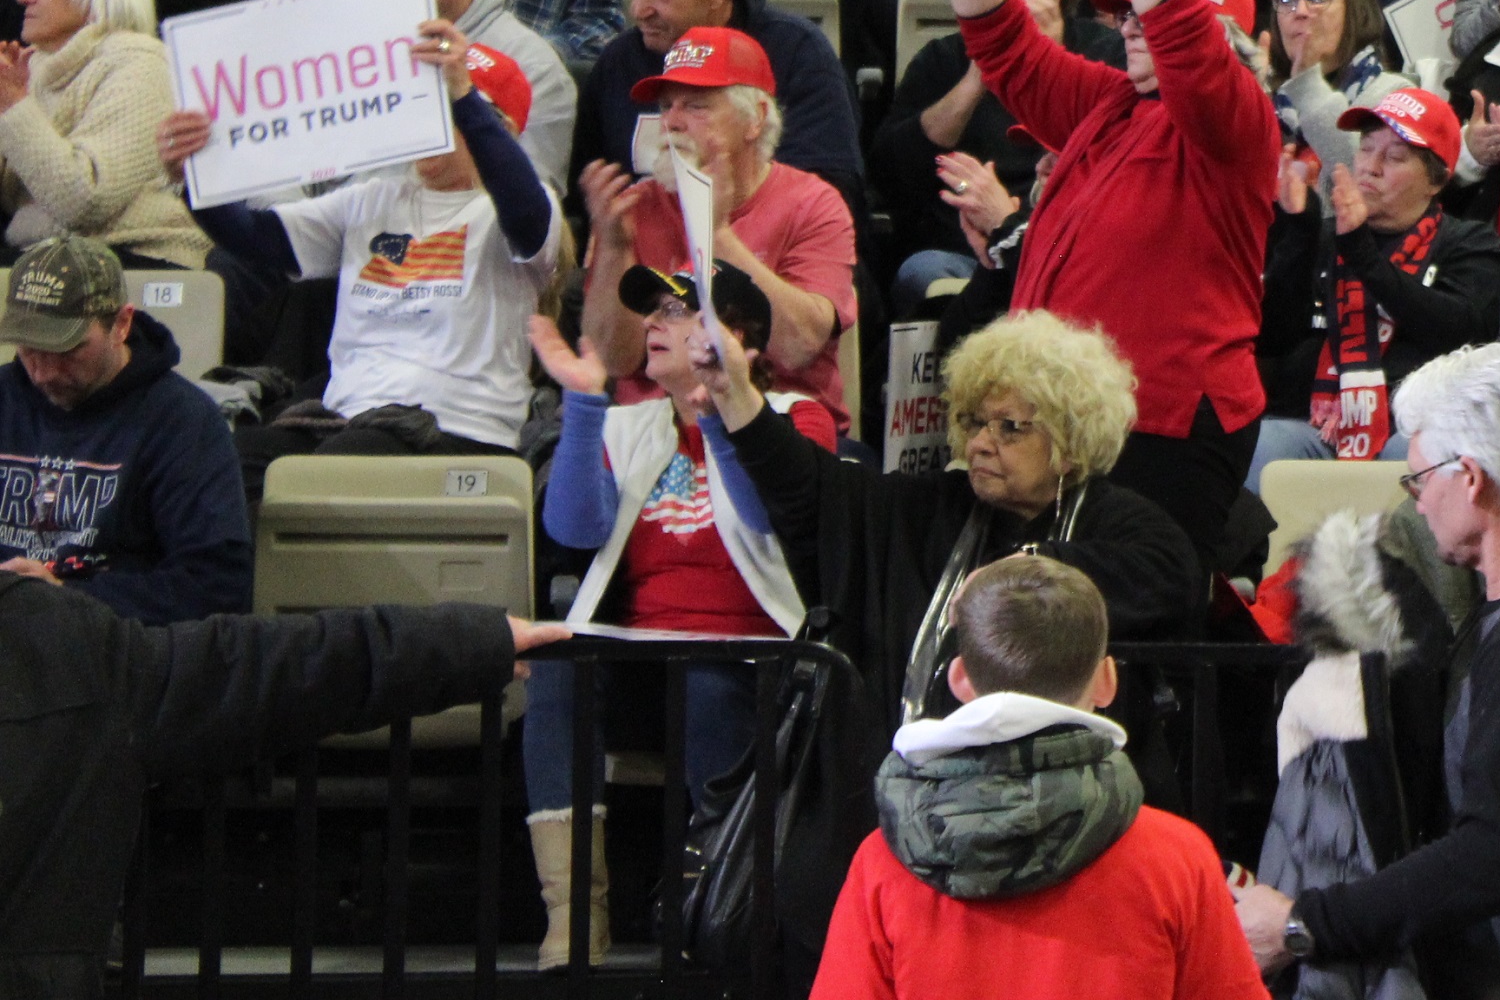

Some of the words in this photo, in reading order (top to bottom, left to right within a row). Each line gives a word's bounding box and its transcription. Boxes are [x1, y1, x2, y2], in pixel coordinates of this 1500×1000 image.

[192, 35, 418, 124] Women
[229, 115, 289, 147] FOR
[300, 92, 402, 133] TRUMP
[22, 269, 66, 291] TRUMP
[154, 286, 172, 304] 18
[351, 284, 376, 298] STAND
[401, 286, 431, 299] BETSY
[911, 352, 940, 385] KEE
[456, 473, 477, 494] 19
